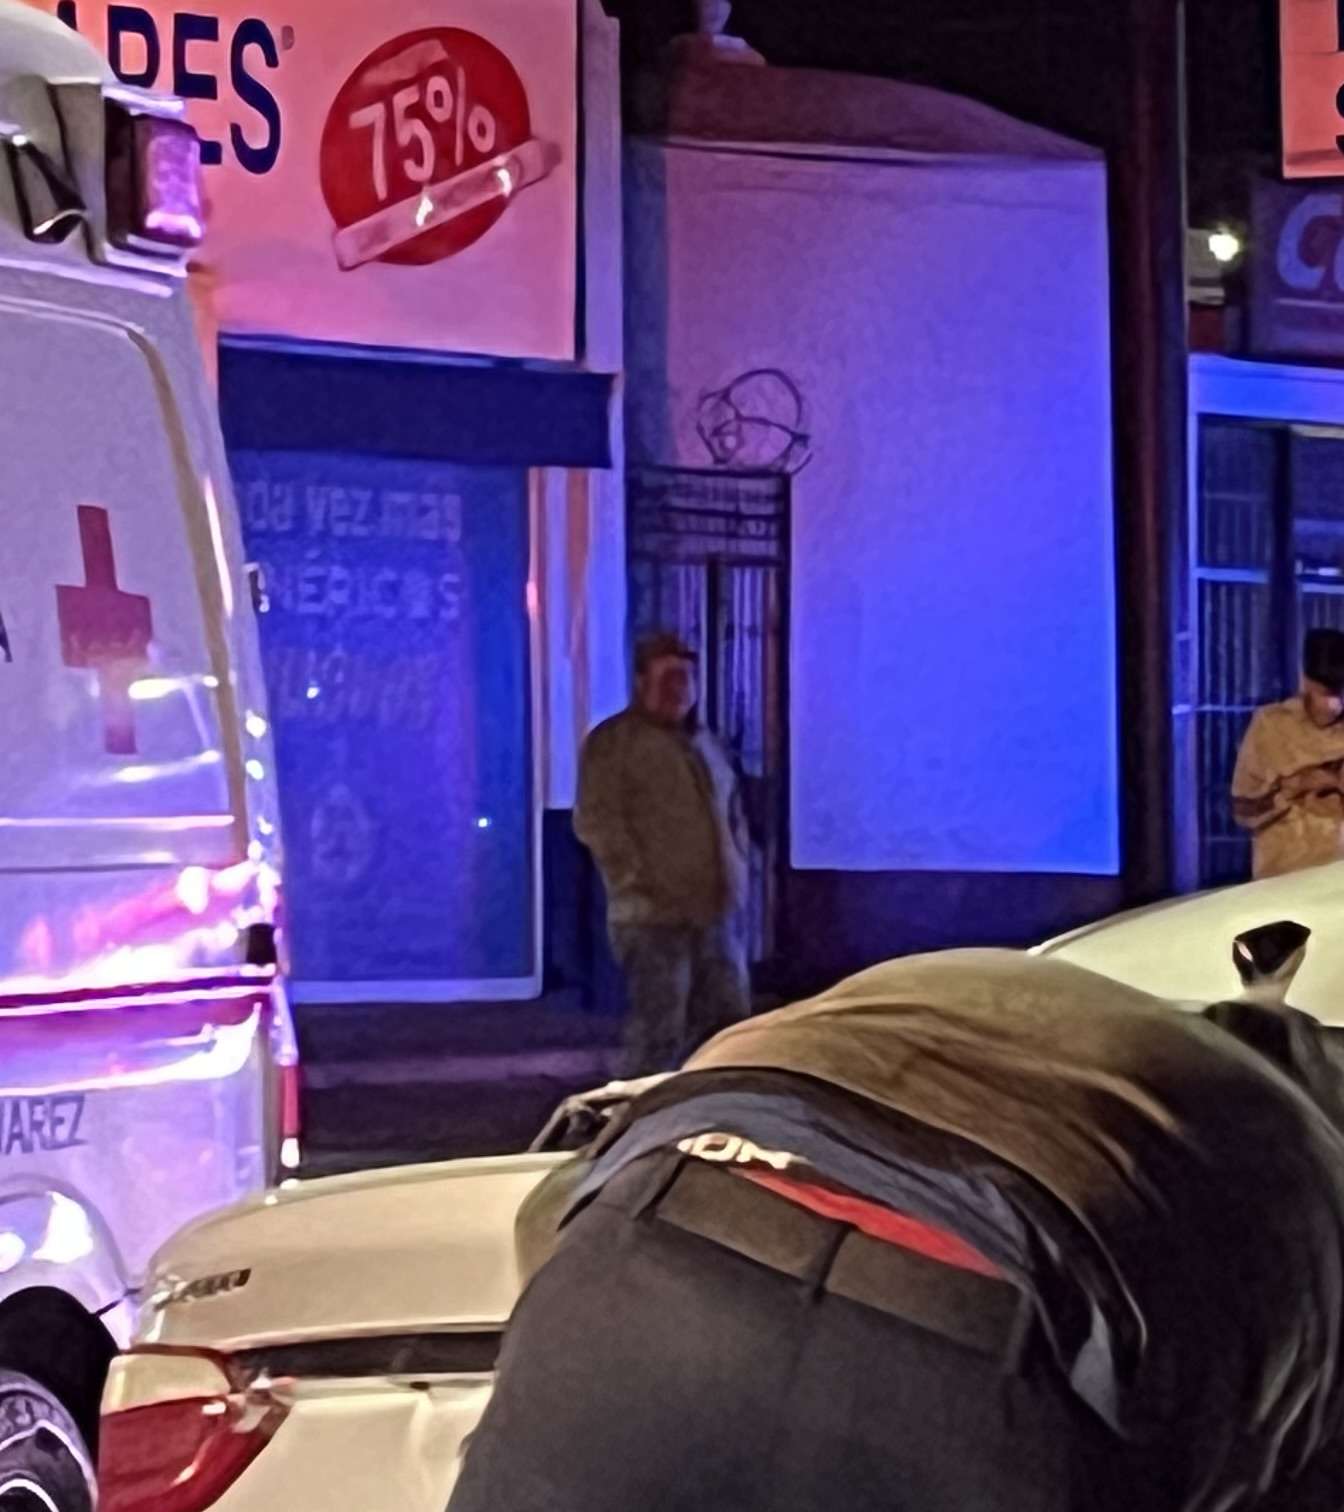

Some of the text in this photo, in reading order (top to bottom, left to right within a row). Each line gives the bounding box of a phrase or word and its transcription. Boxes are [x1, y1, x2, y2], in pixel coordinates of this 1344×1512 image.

[57, 0, 281, 174] RES
[347, 66, 496, 202] 75%
[0, 1095, 88, 1154] AREZ
